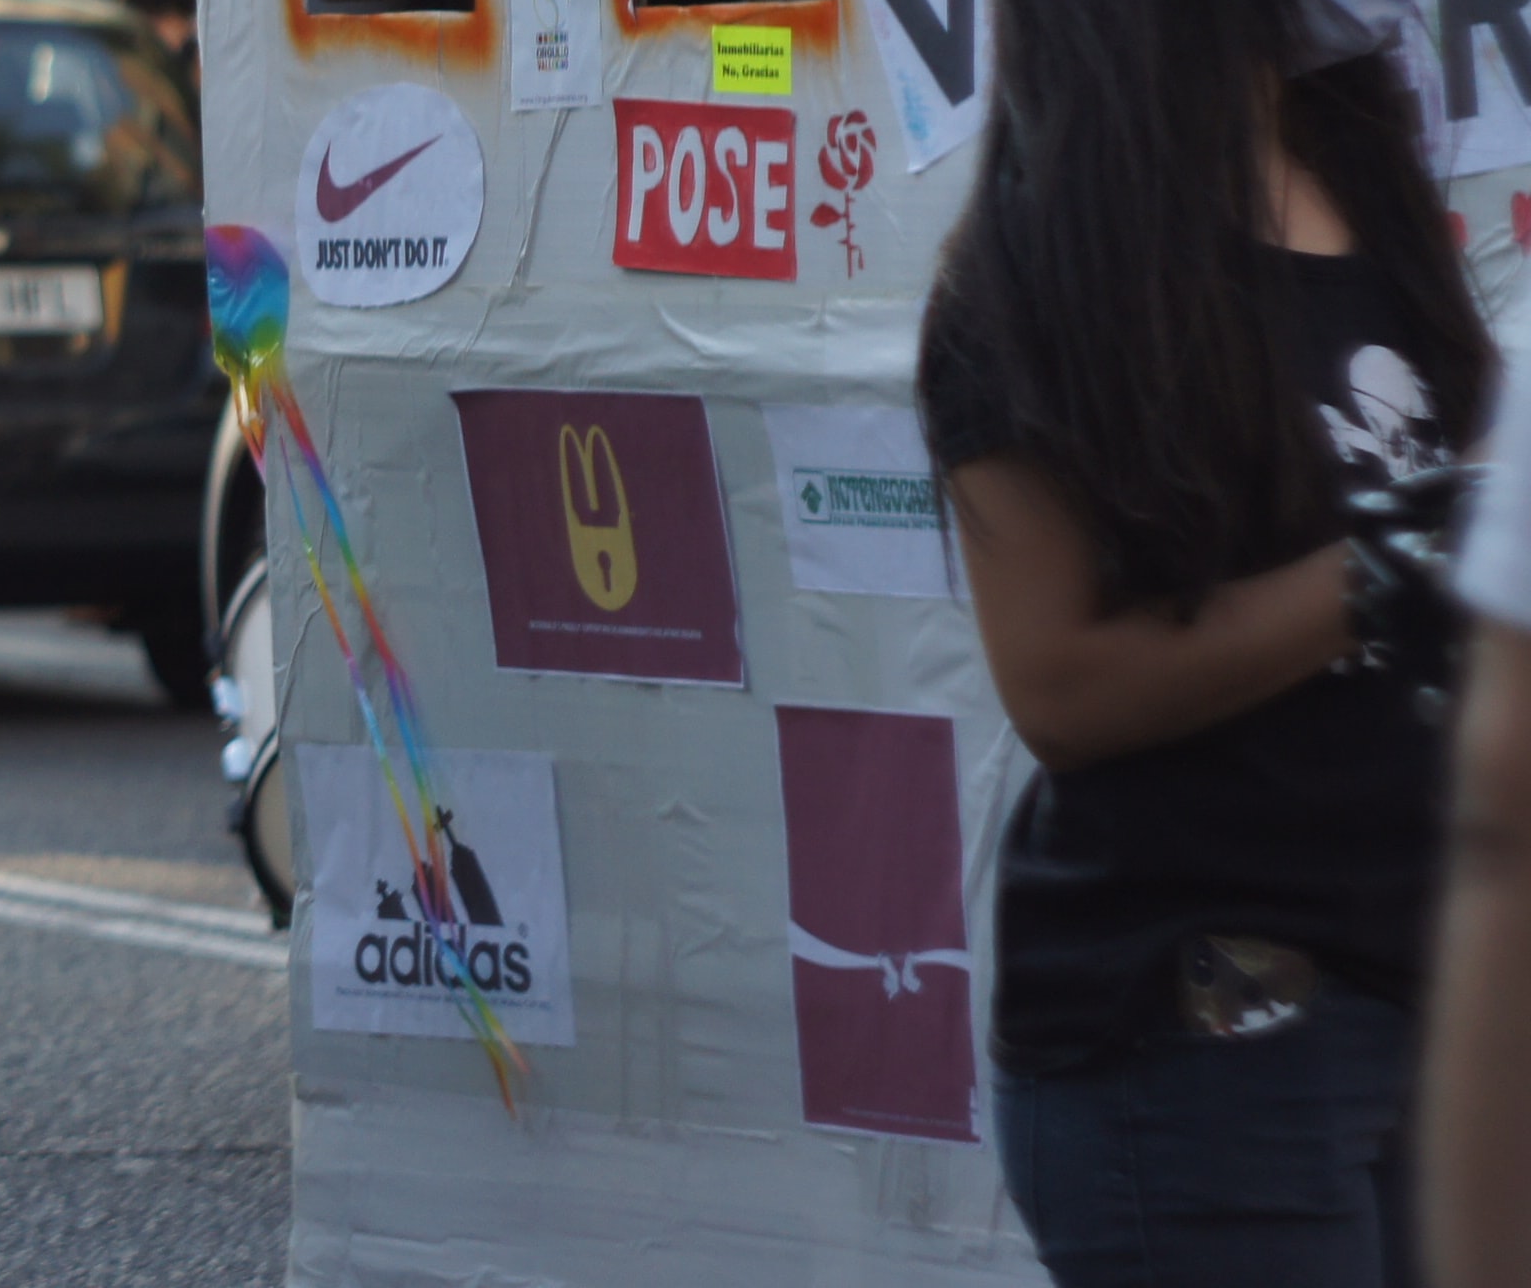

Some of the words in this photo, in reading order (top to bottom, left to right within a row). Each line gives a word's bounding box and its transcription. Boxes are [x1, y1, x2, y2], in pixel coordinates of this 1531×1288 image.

[627, 126, 789, 250] POSE
[316, 238, 350, 269] JUST
[353, 237, 401, 269] DON'T
[404, 237, 429, 268] DO
[355, 921, 531, 993] adidas
